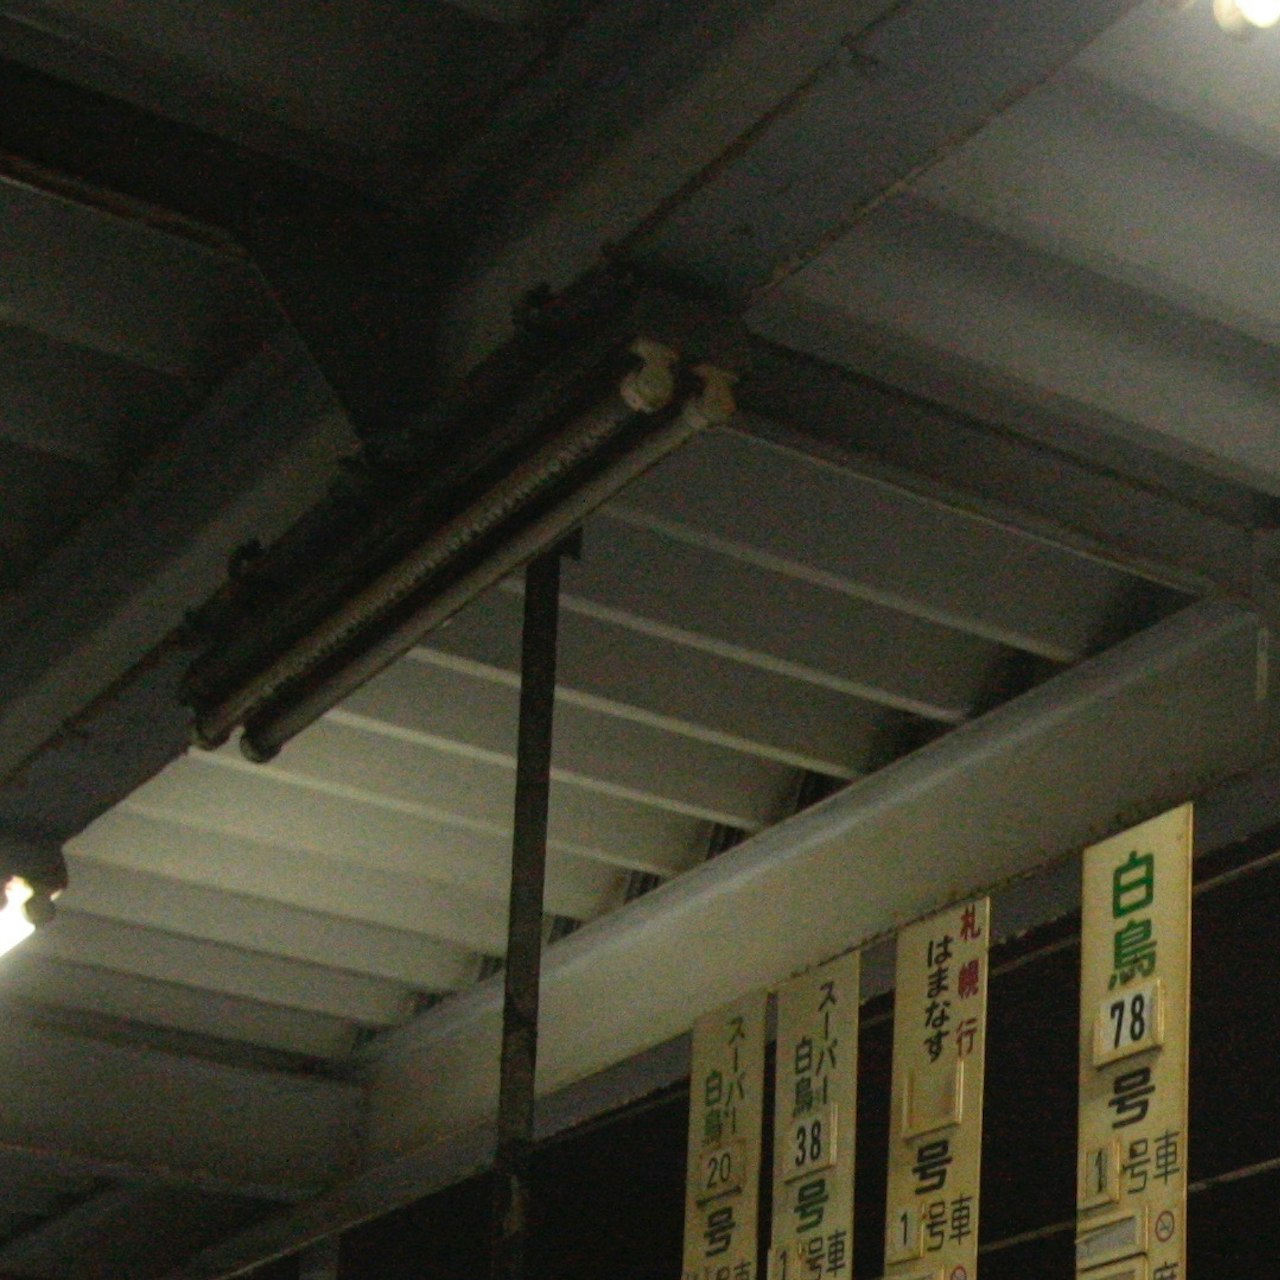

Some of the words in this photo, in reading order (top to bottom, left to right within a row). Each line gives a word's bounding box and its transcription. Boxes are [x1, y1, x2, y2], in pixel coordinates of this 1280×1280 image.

[924, 934, 953, 1063] はまなす
[912, 1138, 953, 1196] 号
